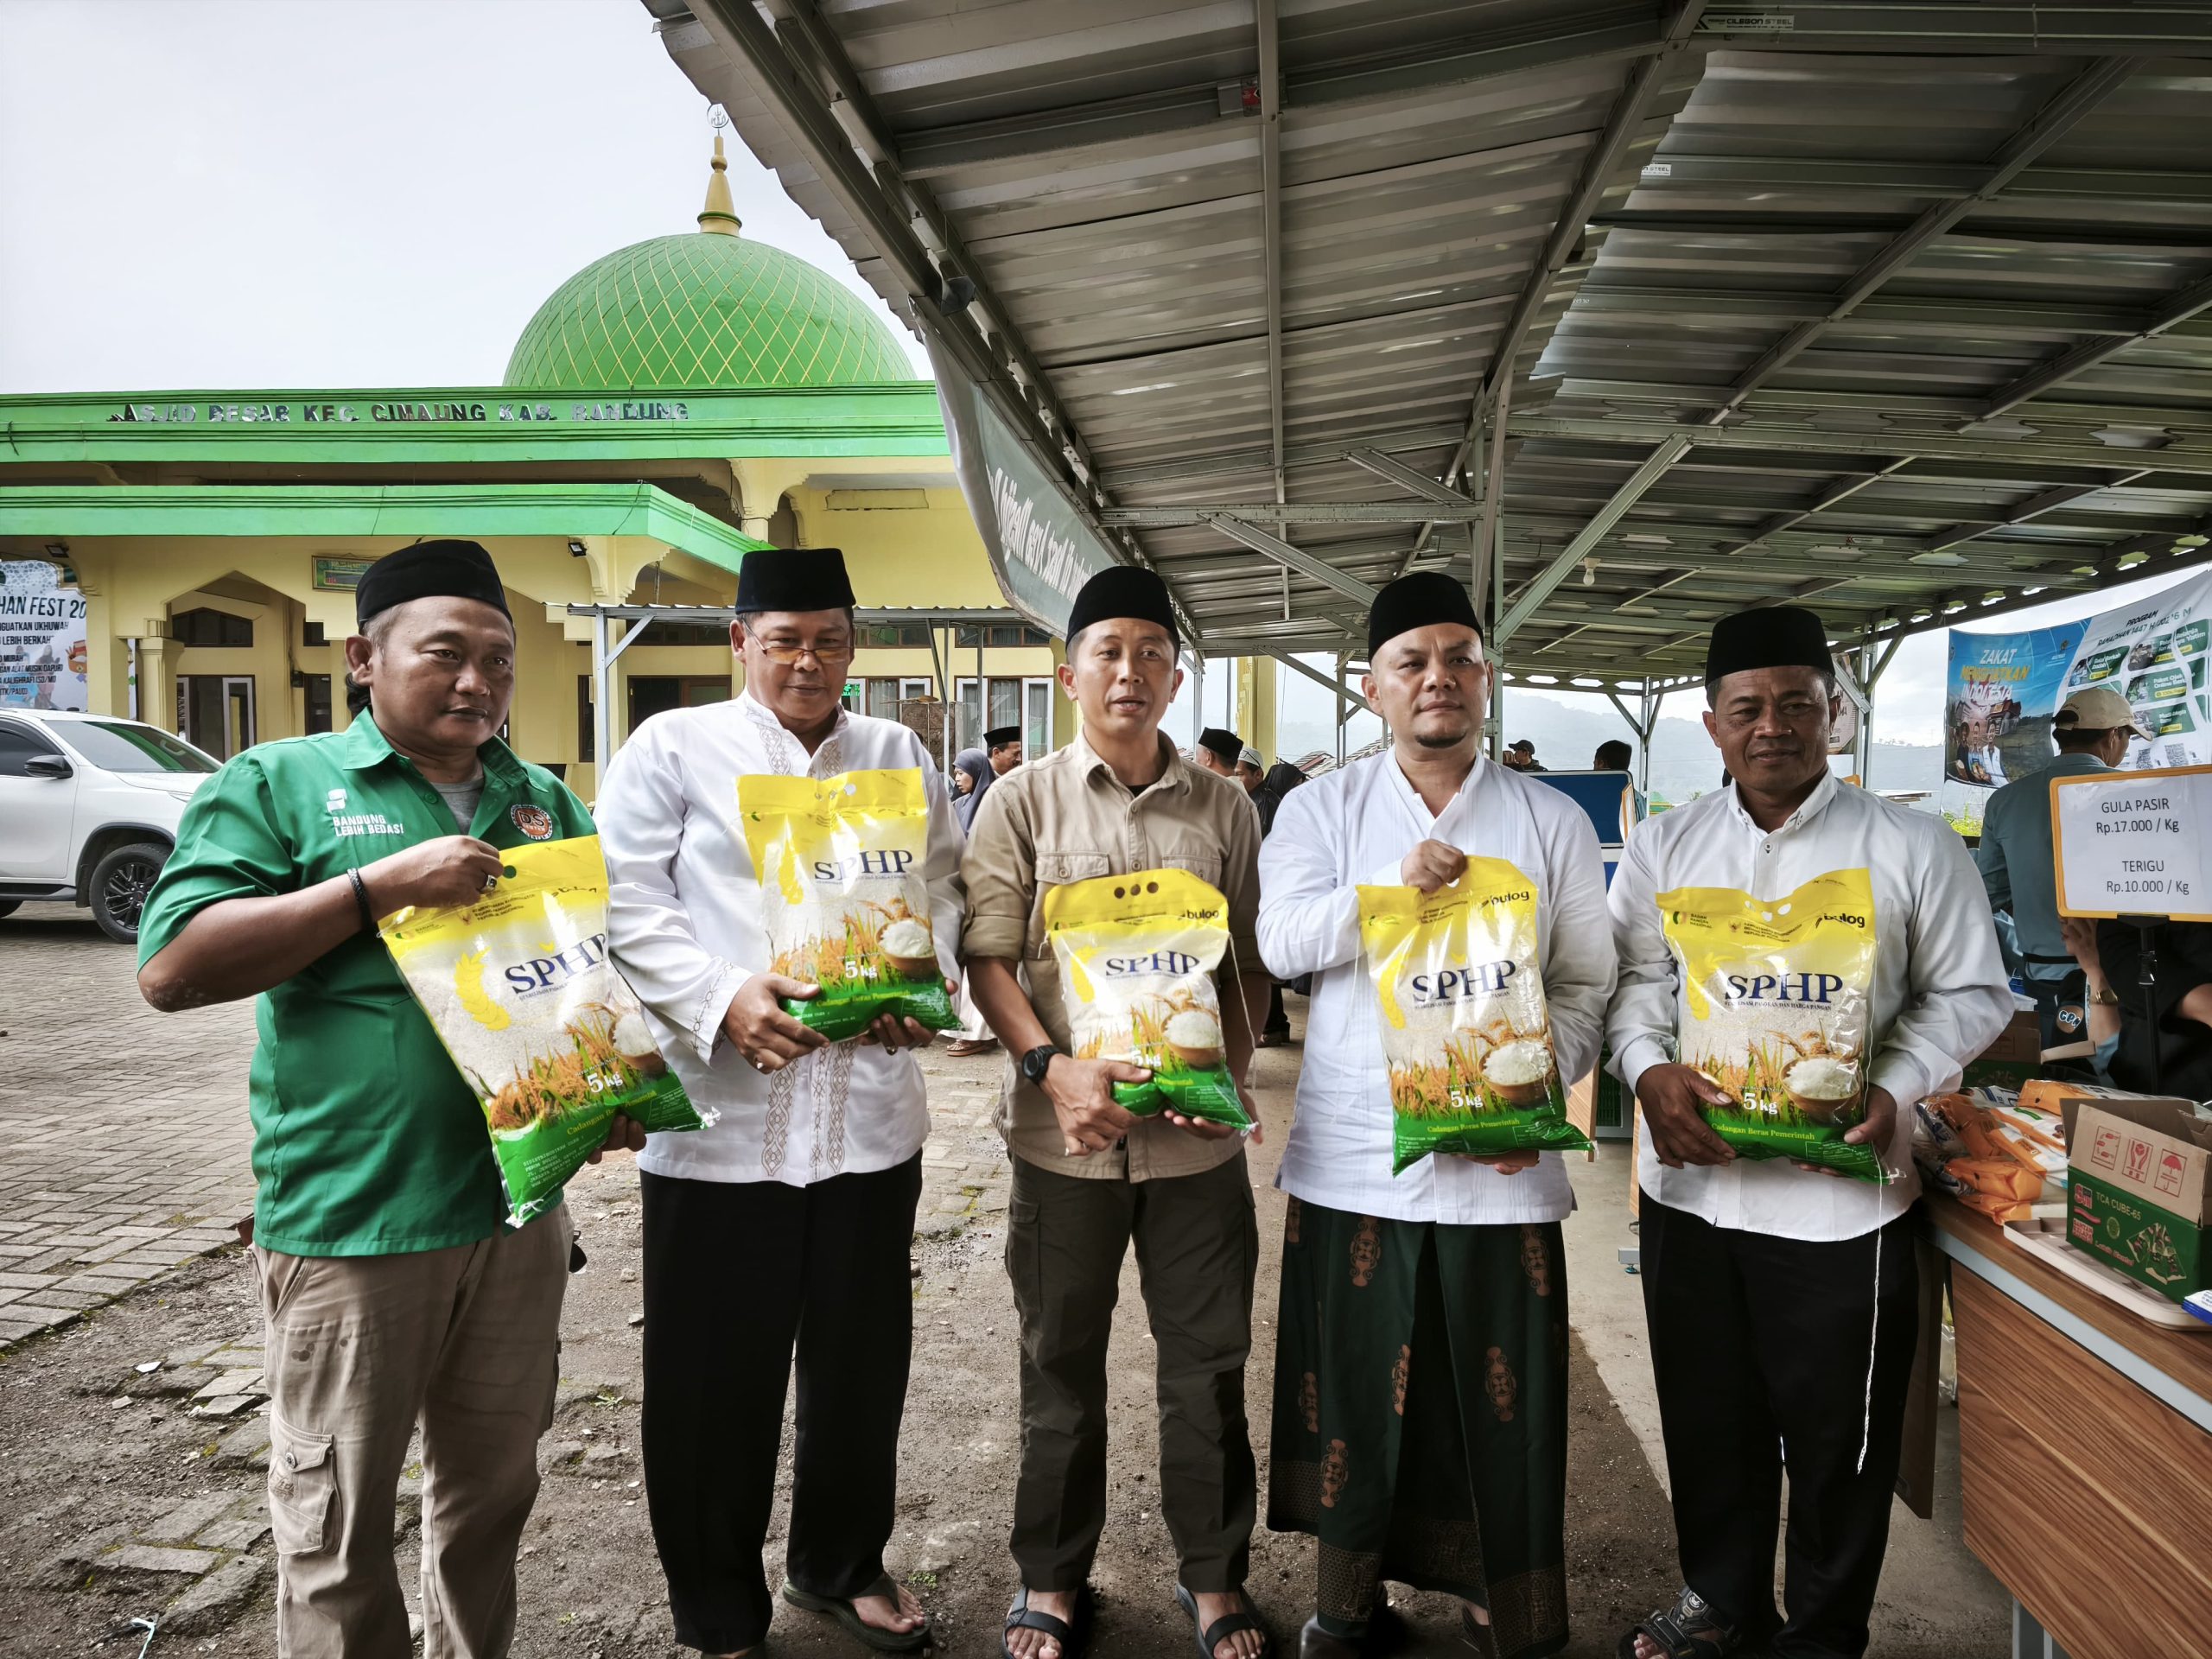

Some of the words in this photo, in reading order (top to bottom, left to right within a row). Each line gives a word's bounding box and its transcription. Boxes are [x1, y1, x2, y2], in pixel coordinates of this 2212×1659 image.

[105, 404, 196, 423] ASJID
[208, 404, 290, 423] BESAR
[370, 403, 486, 422] CIMAUNG
[571, 402, 689, 421] BANDUNG
[29, 596, 67, 617] FEST
[34, 621, 69, 631] UKHUWAH
[2126, 609, 2159, 627] PROGRAM
[2, 635, 22, 645] LEBIH
[1980, 649, 2018, 664] ZAKAT
[1960, 664, 2031, 683] MENGUATKAN
[2101, 800, 2133, 814] GULA
[2136, 798, 2171, 811] PASIR
[332, 813, 387, 827] BANDUNG
[518, 811, 545, 827] DS
[2095, 820, 2153, 835] Rp.17.000
[2156, 817, 2162, 832] /
[2164, 817, 2180, 833] Kg
[334, 825, 364, 838] LEBIH
[367, 823, 404, 836] BEDAS!
[2122, 860, 2165, 873] TERIGU
[2106, 879, 2164, 893] Rp.10.000
[2167, 878, 2172, 893] /
[2175, 879, 2190, 895] Kg
[845, 960, 858, 979] 5
[860, 964, 878, 979] kg
[1106, 950, 1200, 976] SPHP
[1411, 959, 1516, 1002] SPHP
[1725, 972, 1844, 1004] SPHP
[1131, 1049, 1144, 1066] 5
[587, 1072, 604, 1093] 5
[603, 1071, 623, 1088] kg
[1451, 1090, 1464, 1108] 5
[1465, 1095, 1484, 1108] kg
[1743, 1092, 1758, 1110] 5
[1759, 1099, 1778, 1115] kg
[566, 1113, 605, 1136] Cadangan
[1427, 1125, 1459, 1134] Cadangan
[1480, 1118, 1521, 1128] Pemerintah
[1711, 1122, 1746, 1135] Cadangan
[1748, 1127, 1769, 1136] Beras
[1770, 1129, 1815, 1141] Pemerintah
[2095, 1192, 2110, 1206] TCA
[2111, 1198, 2142, 1221] CUBE-65
